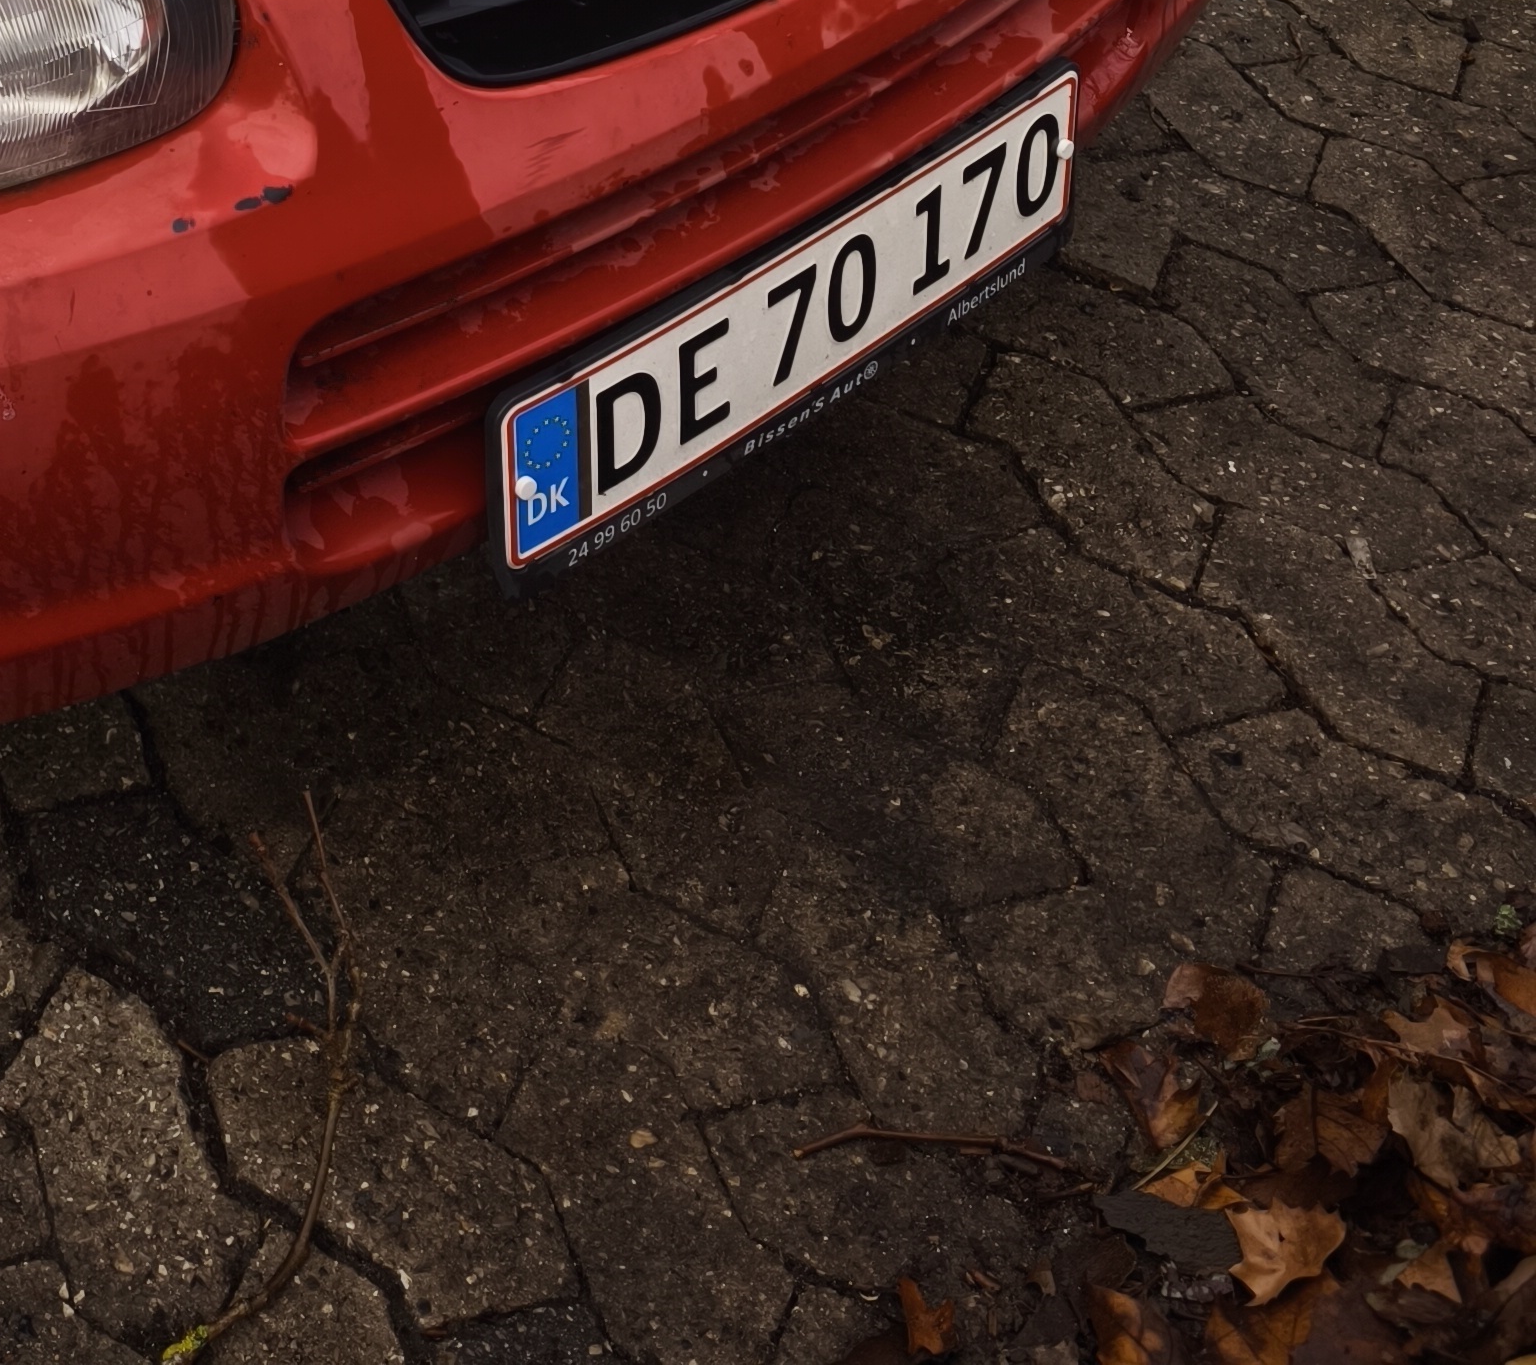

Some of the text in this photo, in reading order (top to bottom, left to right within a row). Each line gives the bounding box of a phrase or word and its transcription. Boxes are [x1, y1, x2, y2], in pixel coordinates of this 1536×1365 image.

[596, 114, 1060, 494] DE 70 170
[947, 257, 1026, 326] Albertslund
[528, 476, 570, 526] DK
[568, 492, 667, 567] 24 99 60 50
